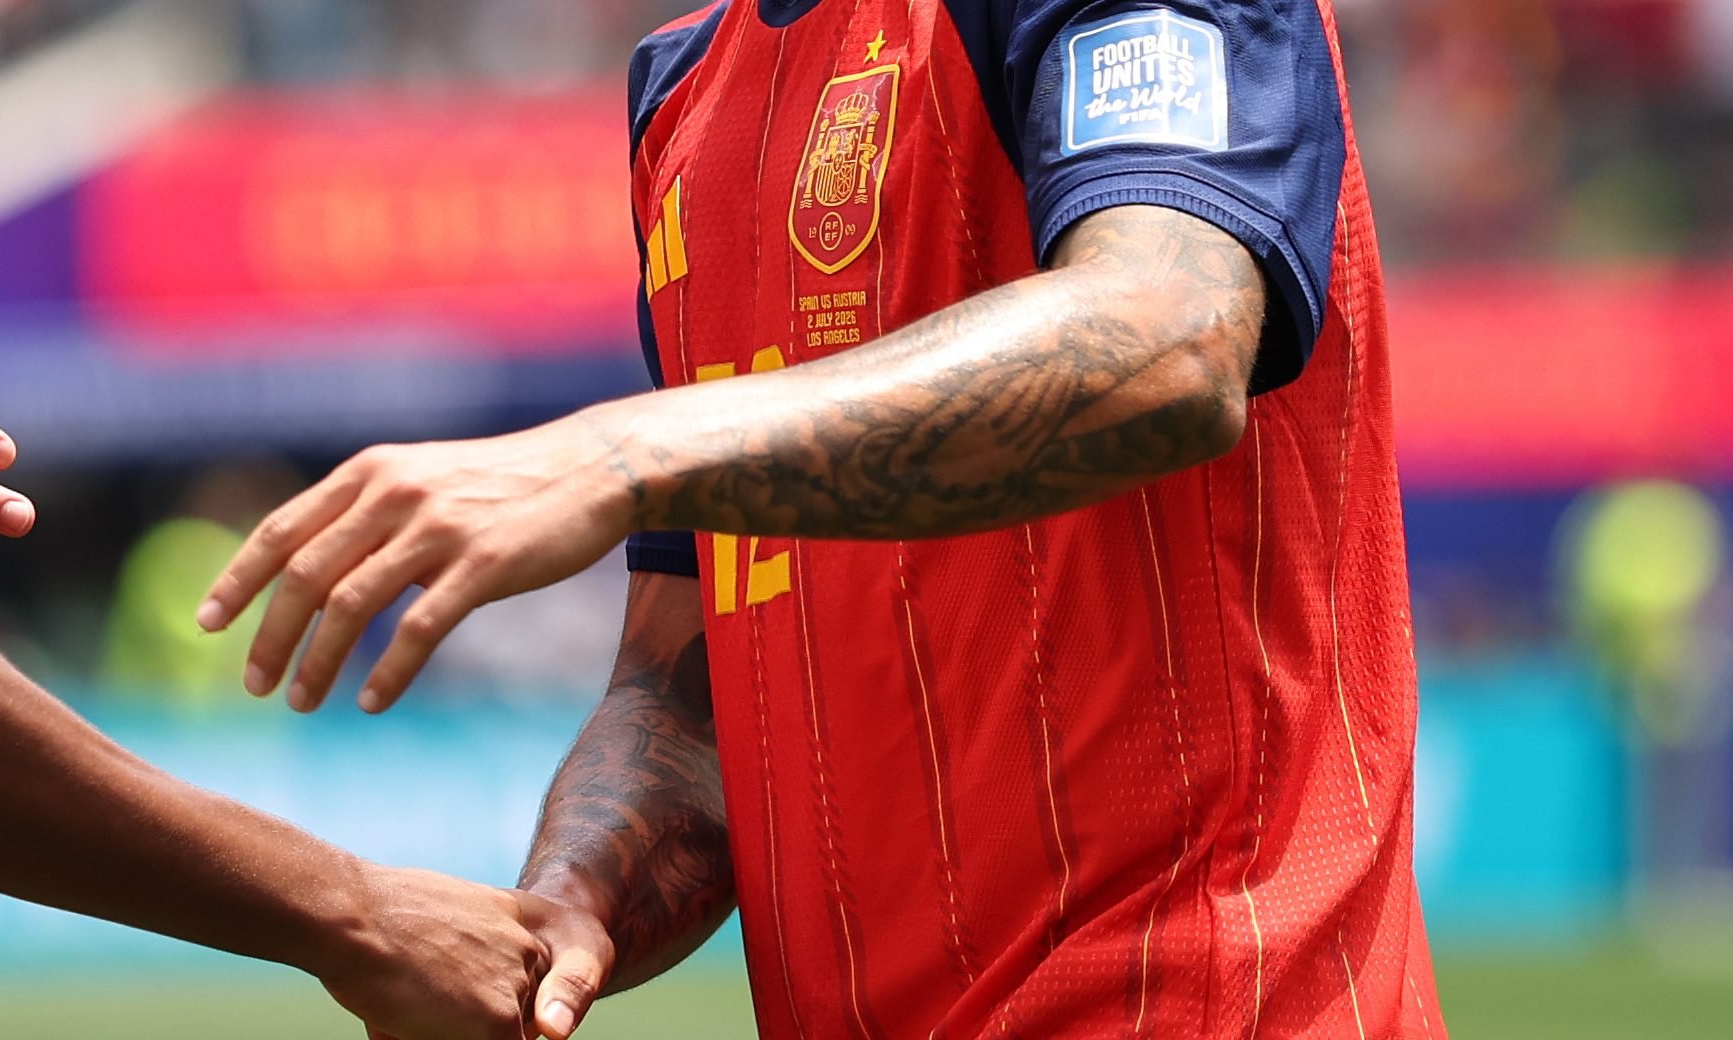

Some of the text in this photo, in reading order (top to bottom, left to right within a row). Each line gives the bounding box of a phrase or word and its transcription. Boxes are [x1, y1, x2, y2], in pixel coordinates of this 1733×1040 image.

[1092, 32, 1195, 70] FOOTBALL
[1092, 52, 1195, 95] UNITES
[1084, 92, 1127, 119] the
[799, 295, 819, 311] SPAIN
[833, 291, 866, 307] AUSTRIA
[807, 310, 857, 329] 2 JULY 2026
[807, 327, 860, 347] LOS ANGELES
